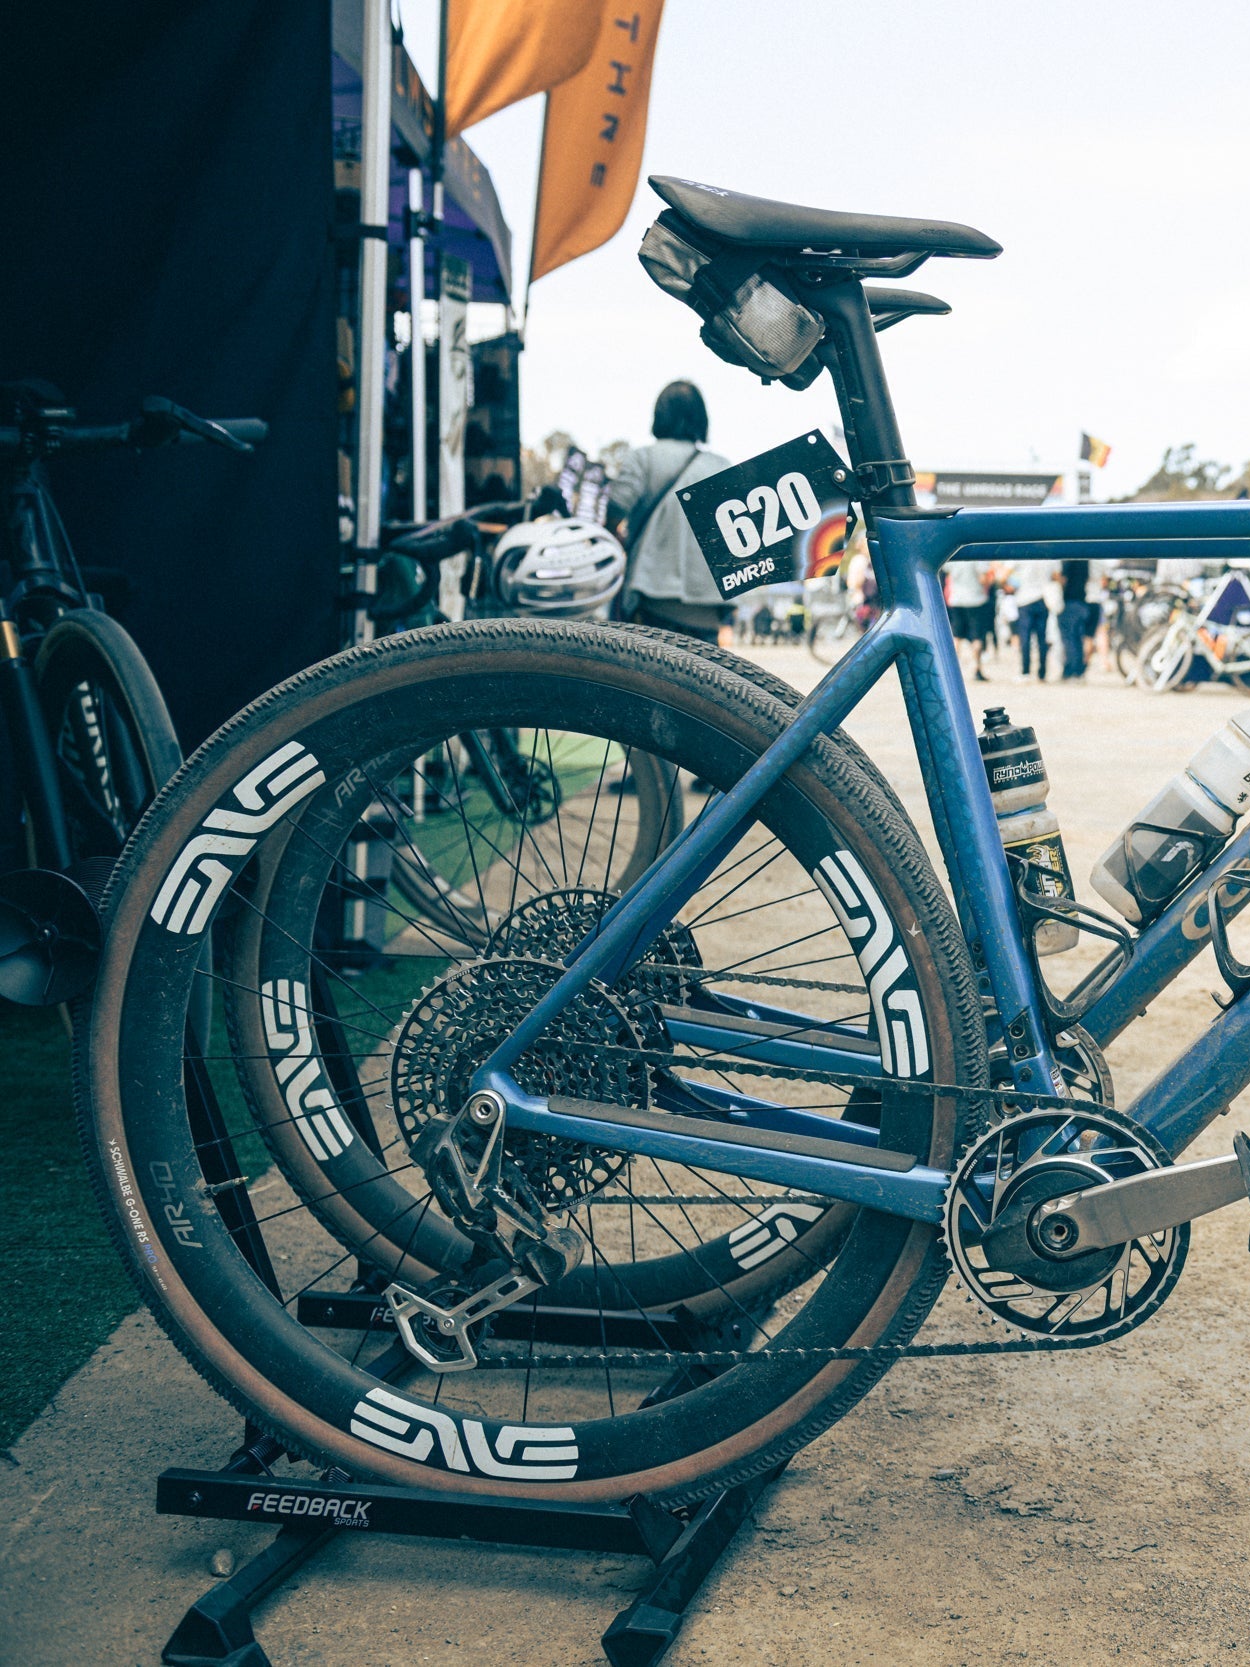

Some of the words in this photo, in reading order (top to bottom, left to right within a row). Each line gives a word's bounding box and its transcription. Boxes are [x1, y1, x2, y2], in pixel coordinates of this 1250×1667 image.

[715, 471, 822, 558] 620
[722, 557, 775, 592] BWR26
[151, 740, 327, 936] ENVE
[812, 849, 931, 1079] ENVE
[261, 978, 355, 1163] ENVE
[109, 1146, 134, 1197] SCHWALBE
[125, 1197, 145, 1230] G-ONE
[136, 1231, 150, 1243] RS
[962, 1157, 978, 1182] SRAM
[350, 1387, 580, 1480] ENVE
[247, 1492, 373, 1520] FEEDBACK
[333, 1516, 371, 1529] SPORTS
